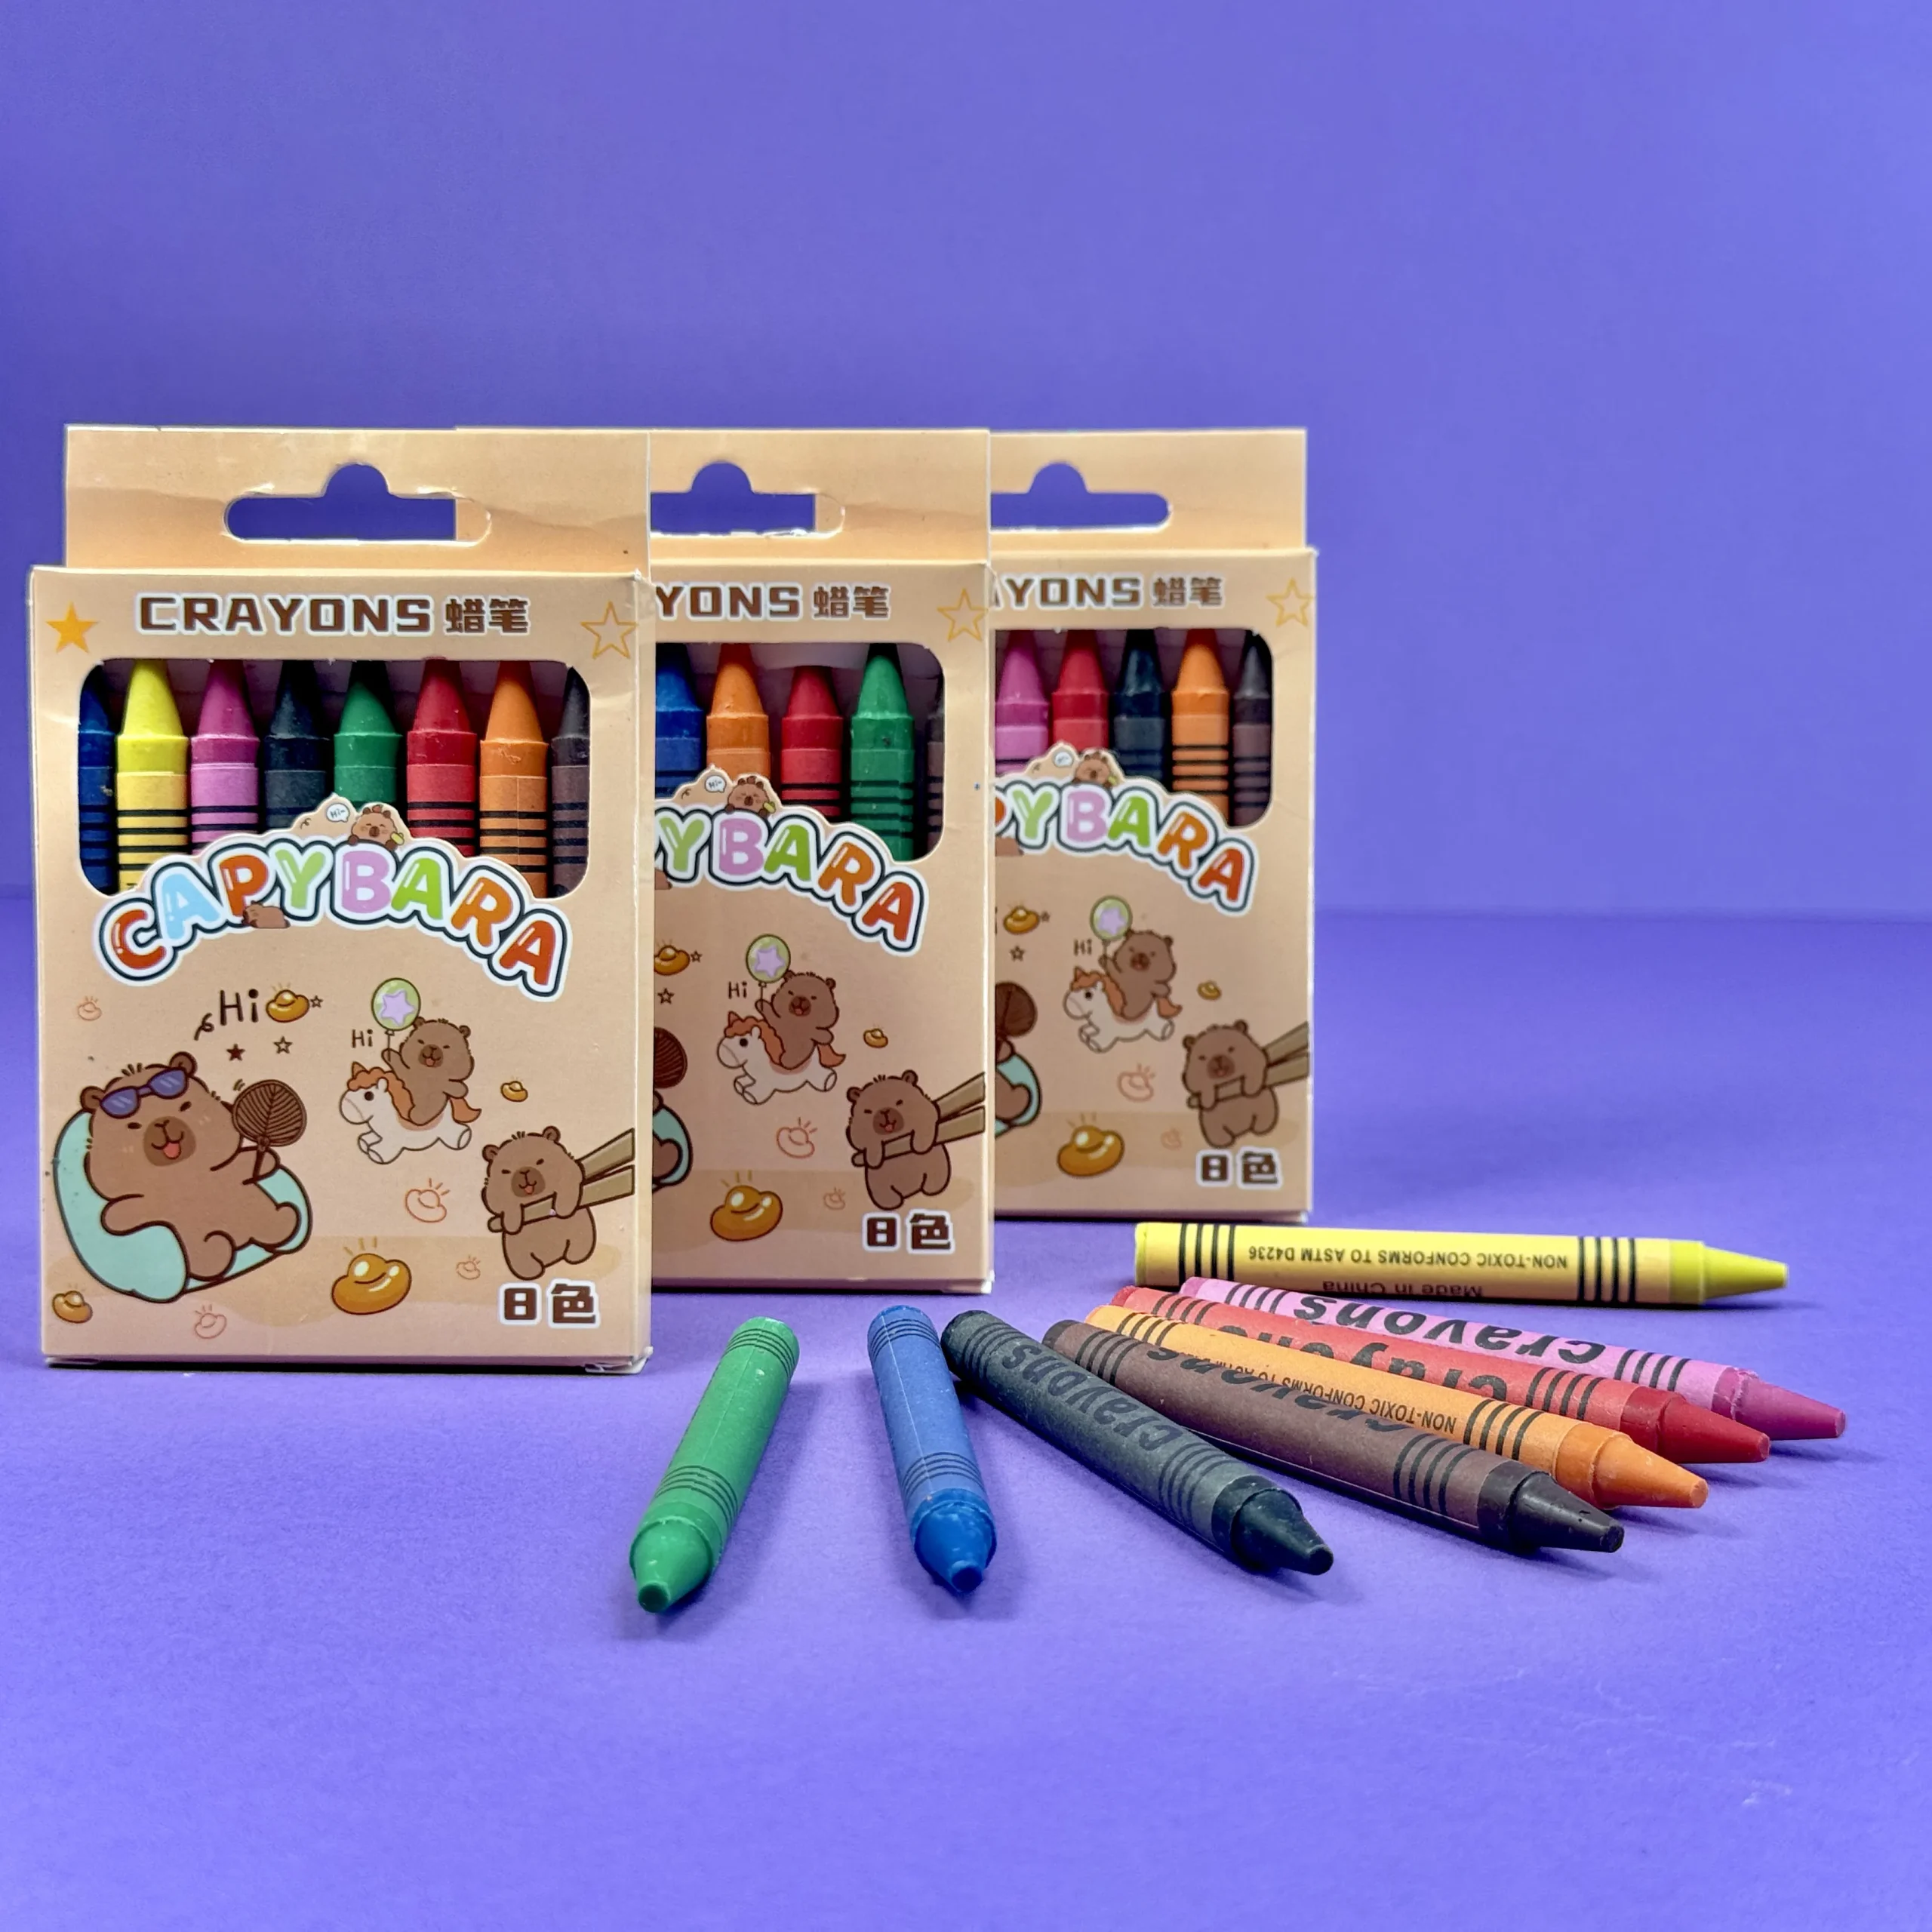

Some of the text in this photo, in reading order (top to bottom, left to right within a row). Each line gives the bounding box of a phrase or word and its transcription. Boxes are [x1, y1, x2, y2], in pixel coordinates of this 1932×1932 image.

[813, 585, 890, 619] 蜡笔
[1153, 576, 1223, 608] 蜡笔
[140, 596, 529, 634] CRAYONS 蜡笔
[100, 838, 568, 998] CAPYBARA
[1073, 938, 1093, 957] Hi
[728, 980, 748, 1000] Hi
[219, 988, 259, 1026] Hi
[351, 1028, 374, 1049] Hi
[1247, 1245, 1567, 1269] NON-TOXIC CONFORMS TO ASTM D4236
[1322, 1281, 1483, 1297] Made in China
[1001, 1344, 1184, 1451] crayons
[1369, 1398, 1457, 1435] NON-TOXIC
